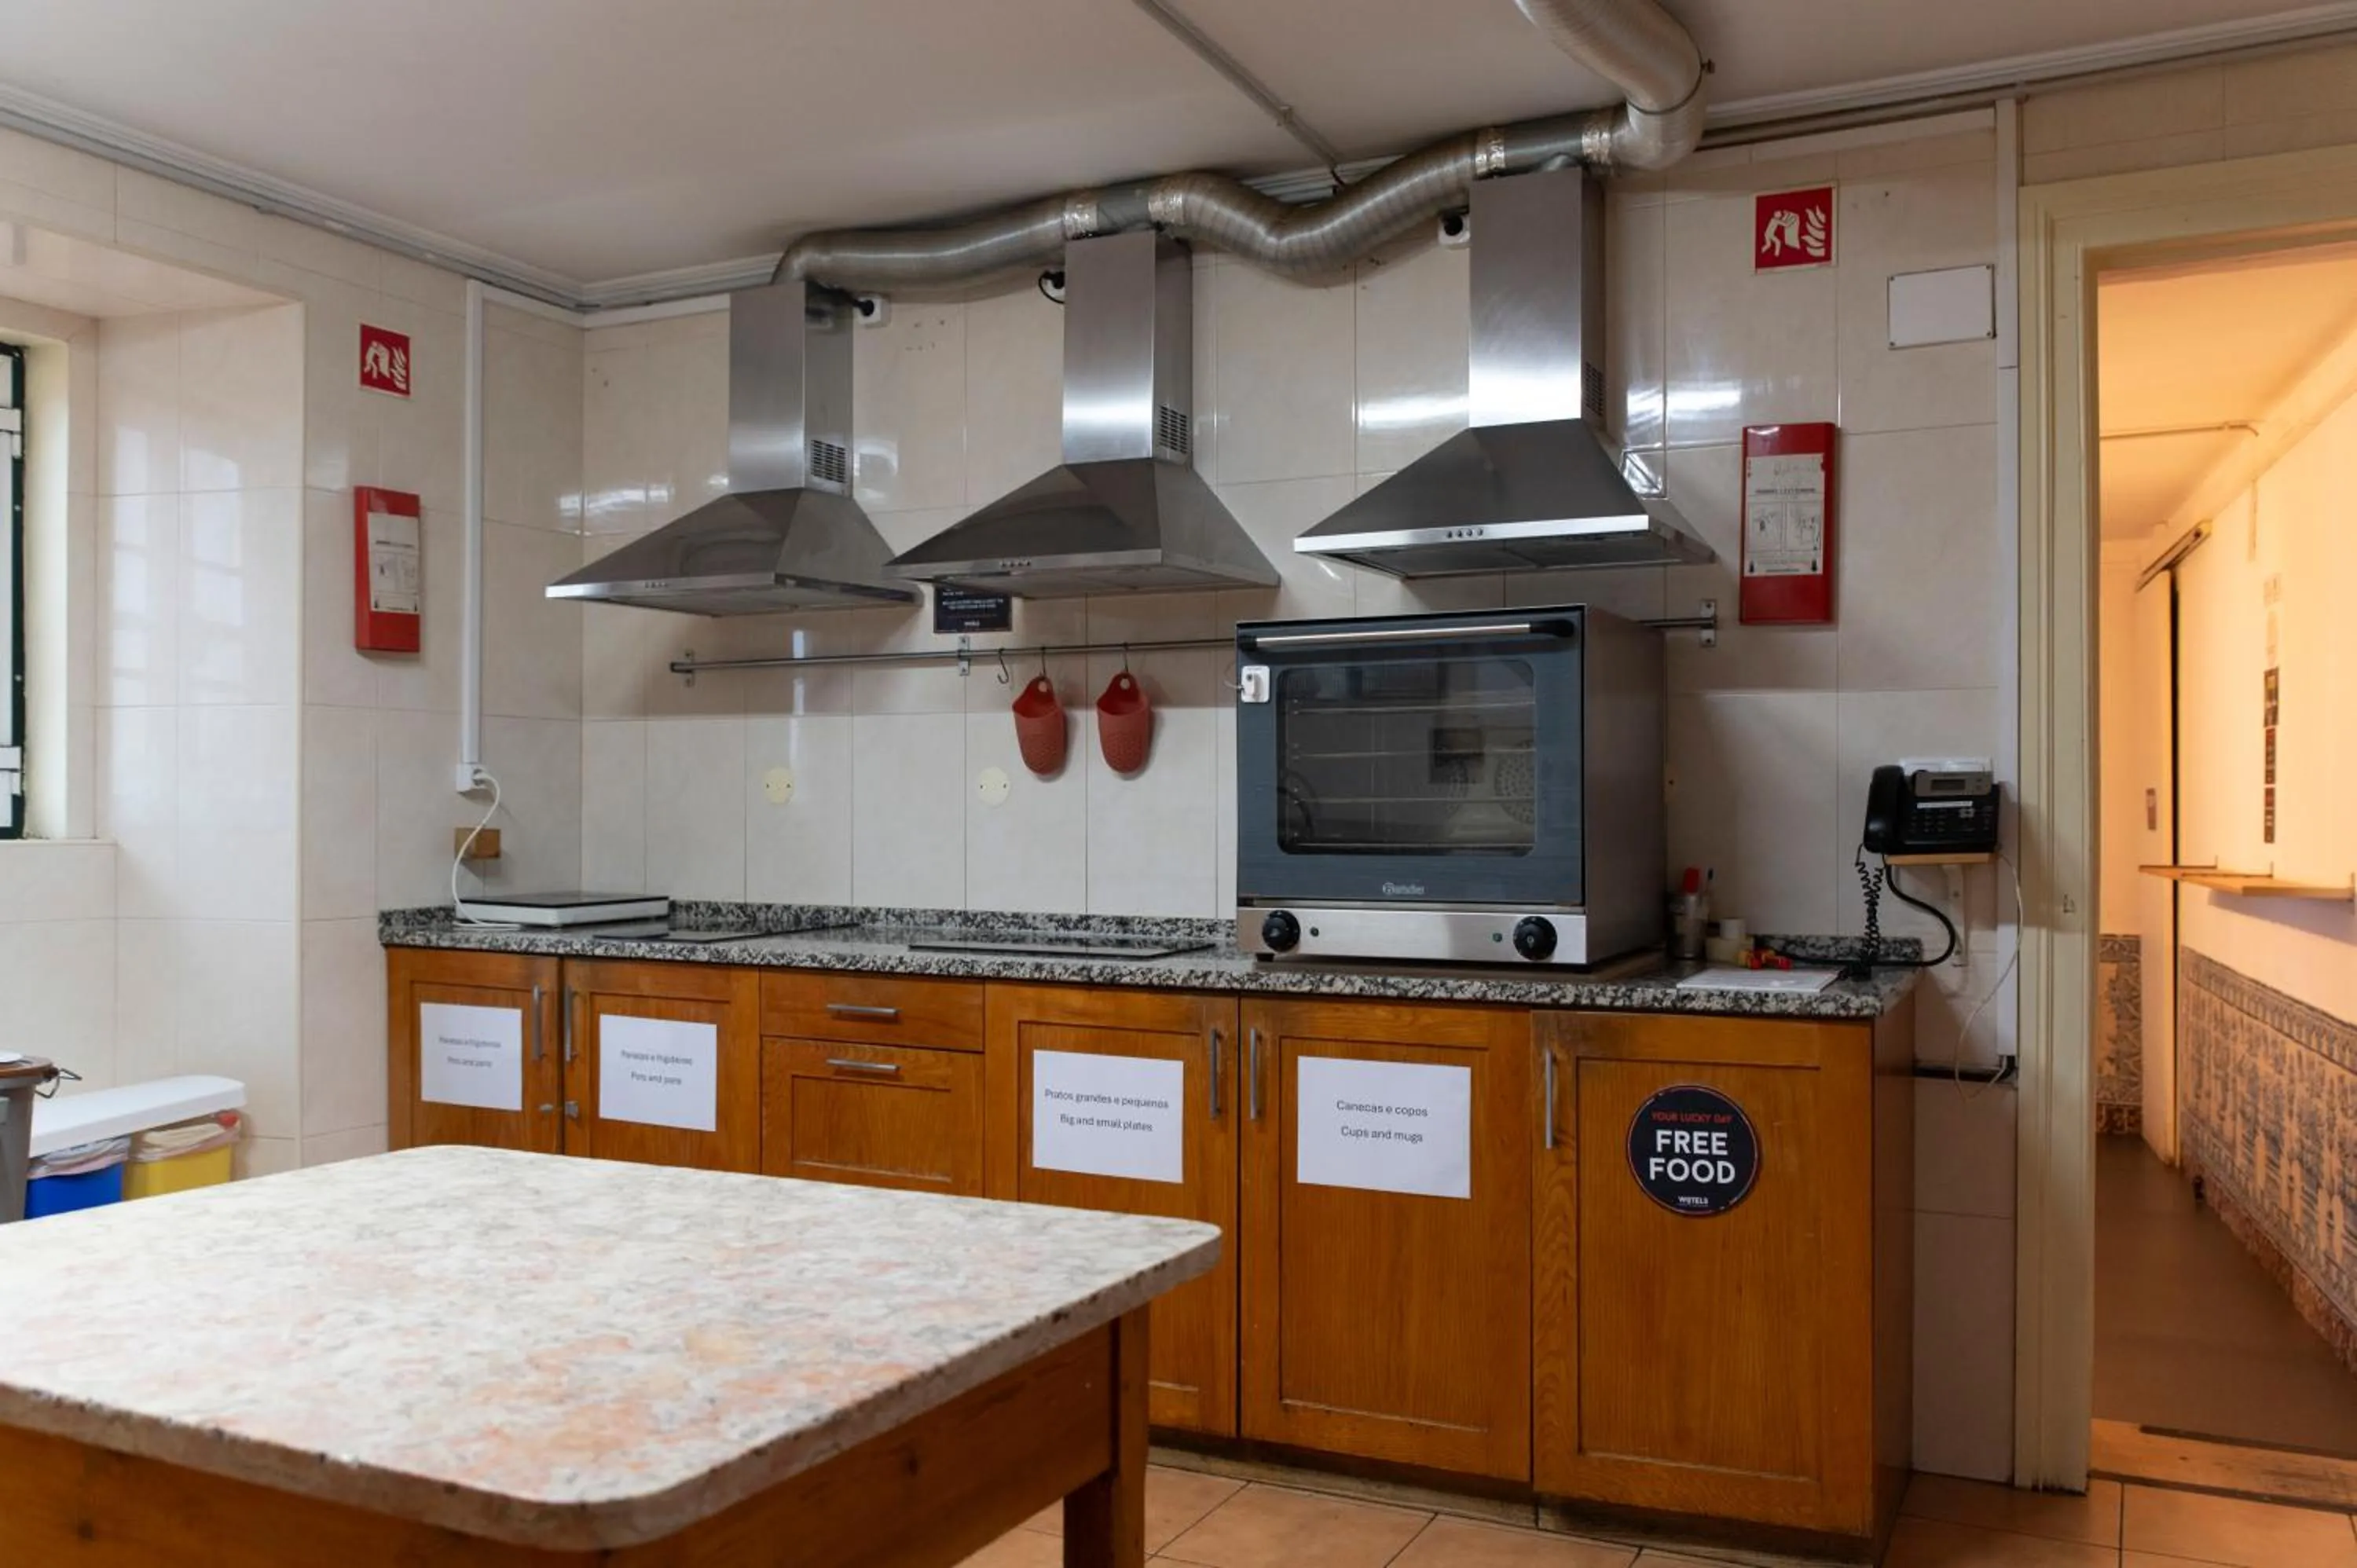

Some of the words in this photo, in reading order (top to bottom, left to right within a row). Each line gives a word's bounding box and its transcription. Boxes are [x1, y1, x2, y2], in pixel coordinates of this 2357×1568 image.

[1044, 1089, 1073, 1101] Pratos
[1076, 1093, 1112, 1105] grandes
[1121, 1097, 1169, 1109] pequenos
[1336, 1100, 1384, 1113] Canecas
[1395, 1107, 1428, 1116] copos
[1061, 1114, 1074, 1126] Big
[1076, 1116, 1094, 1126] and
[1096, 1119, 1121, 1128] small
[1124, 1121, 1153, 1132] plates
[1680, 1112, 1712, 1123] LUCKY
[1341, 1126, 1369, 1138] Cups
[1371, 1130, 1391, 1139] and
[1394, 1131, 1423, 1144] mugs
[1656, 1129, 1728, 1156] FREE
[1649, 1157, 1736, 1184] FOOD
